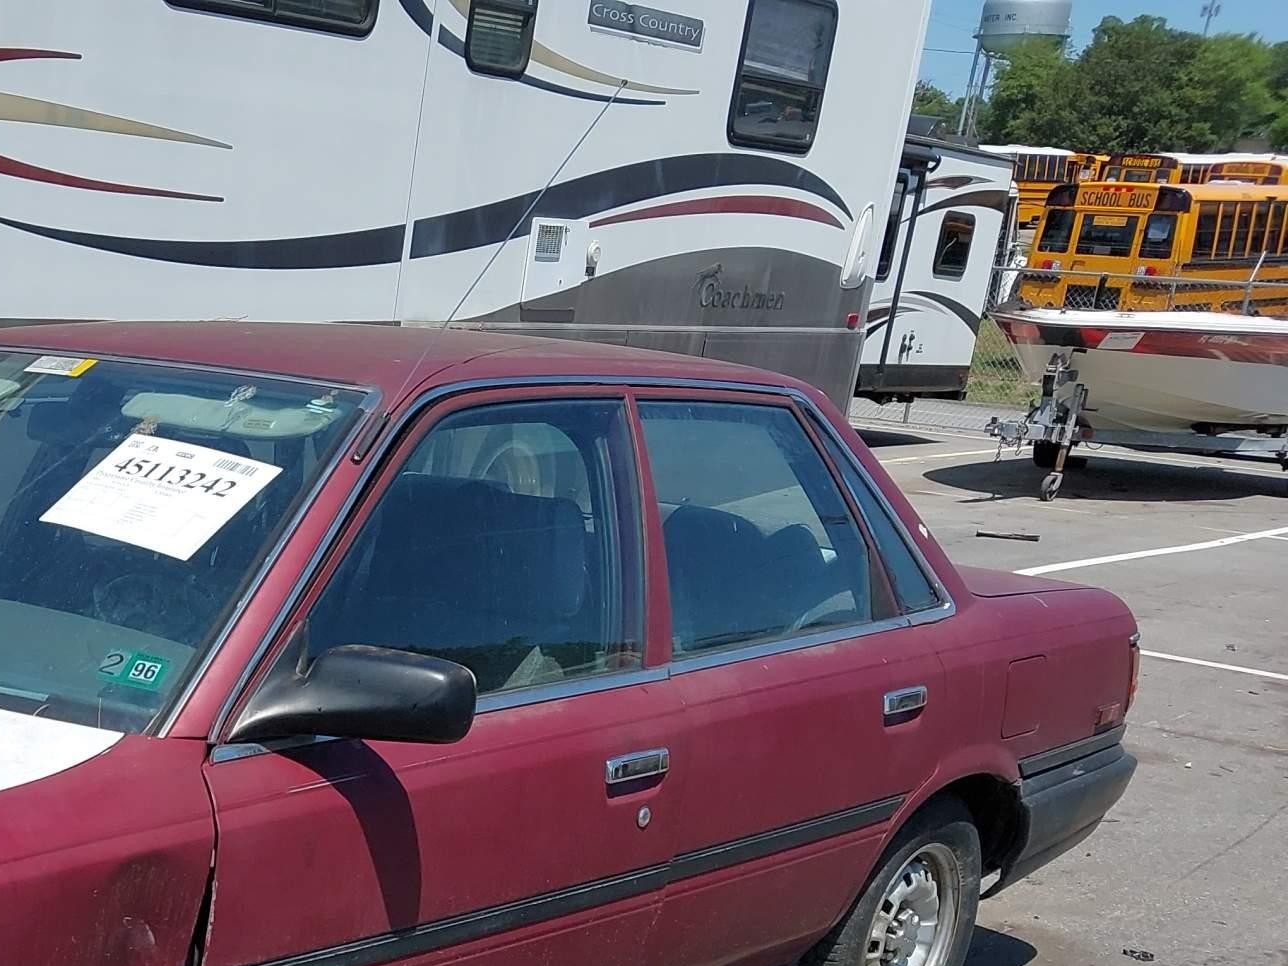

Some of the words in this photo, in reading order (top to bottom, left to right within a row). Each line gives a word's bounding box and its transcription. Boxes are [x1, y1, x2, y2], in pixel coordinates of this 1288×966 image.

[592, 4, 635, 24] Cross
[639, 14, 700, 40] Country
[1080, 191, 1122, 207] SCHOOL
[1128, 193, 1152, 208] BUS
[699, 283, 785, 311] Coachmen
[114, 457, 237, 498] 45113242
[98, 653, 124, 676] 2
[132, 662, 159, 679] 96
